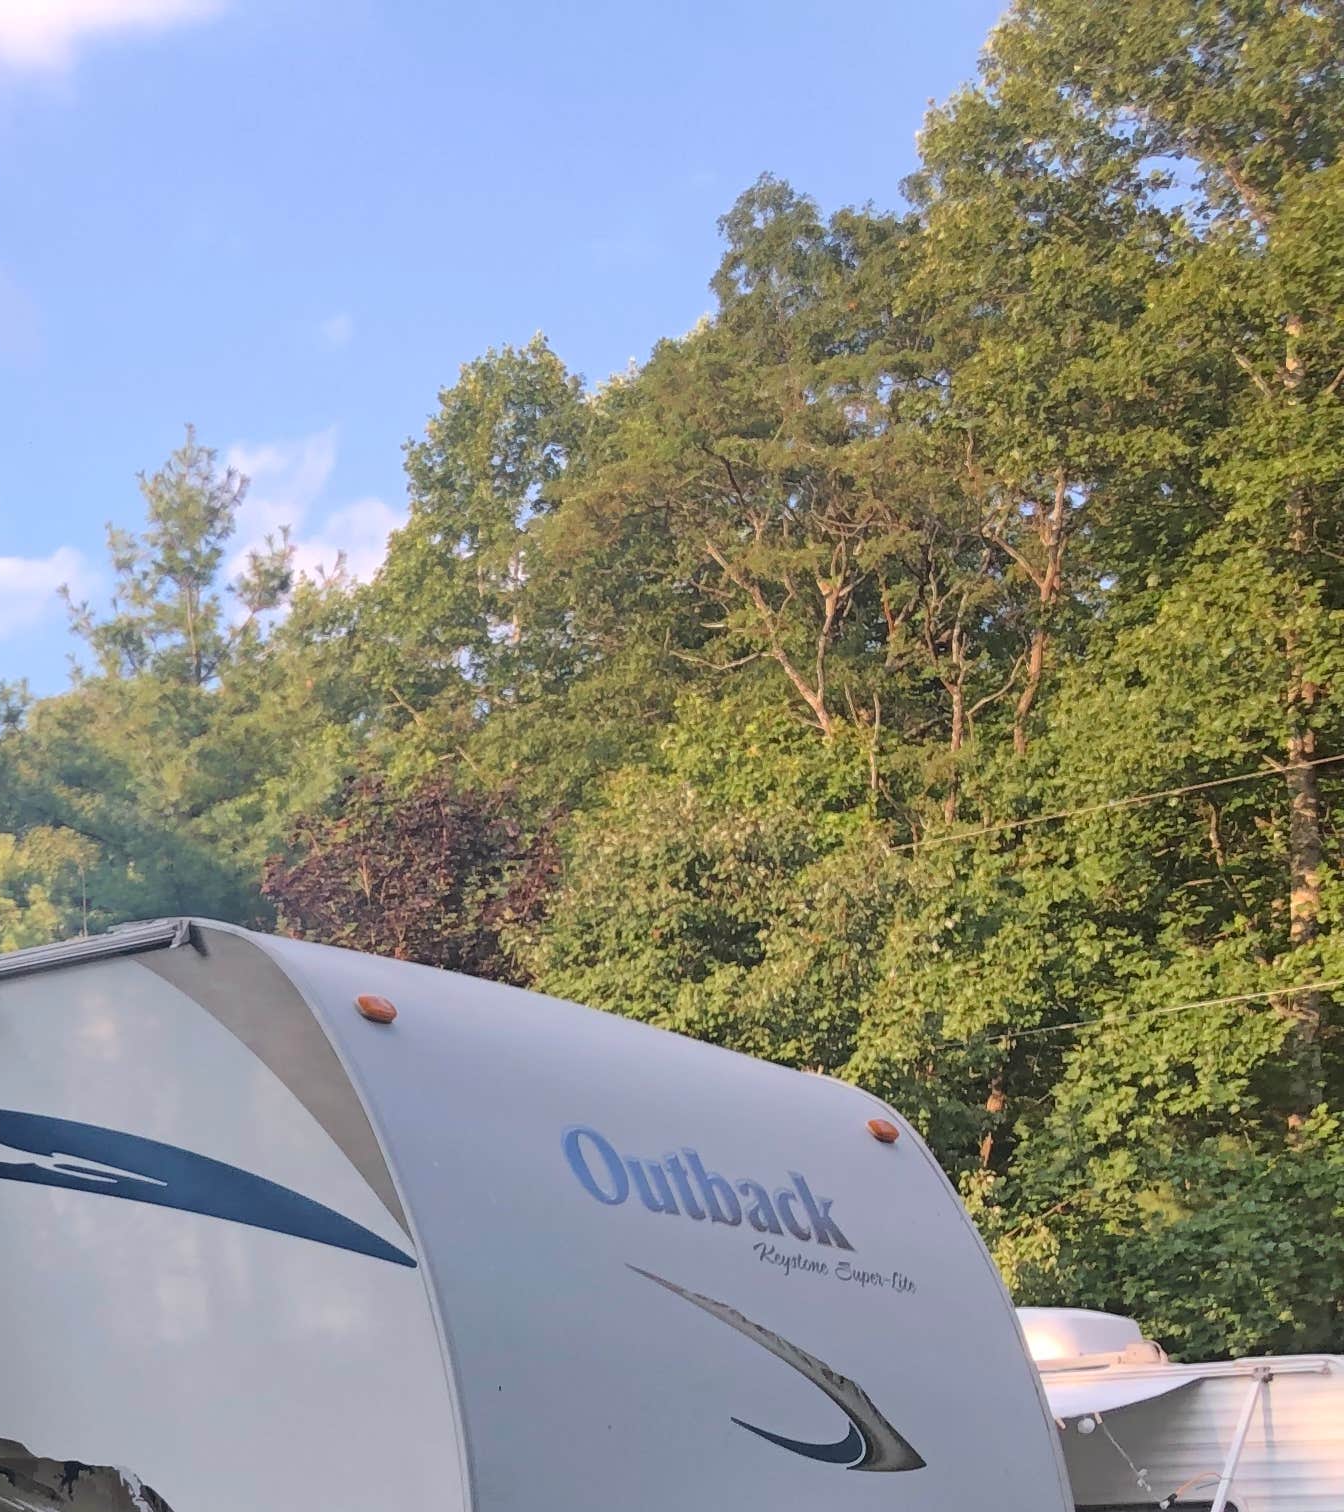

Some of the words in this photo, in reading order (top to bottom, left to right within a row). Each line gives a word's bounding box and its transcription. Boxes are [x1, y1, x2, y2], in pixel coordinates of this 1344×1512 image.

[561, 1124, 858, 1252] Outback
[753, 1241, 829, 1276] Keystone
[835, 1261, 916, 1294] Super-Lite
